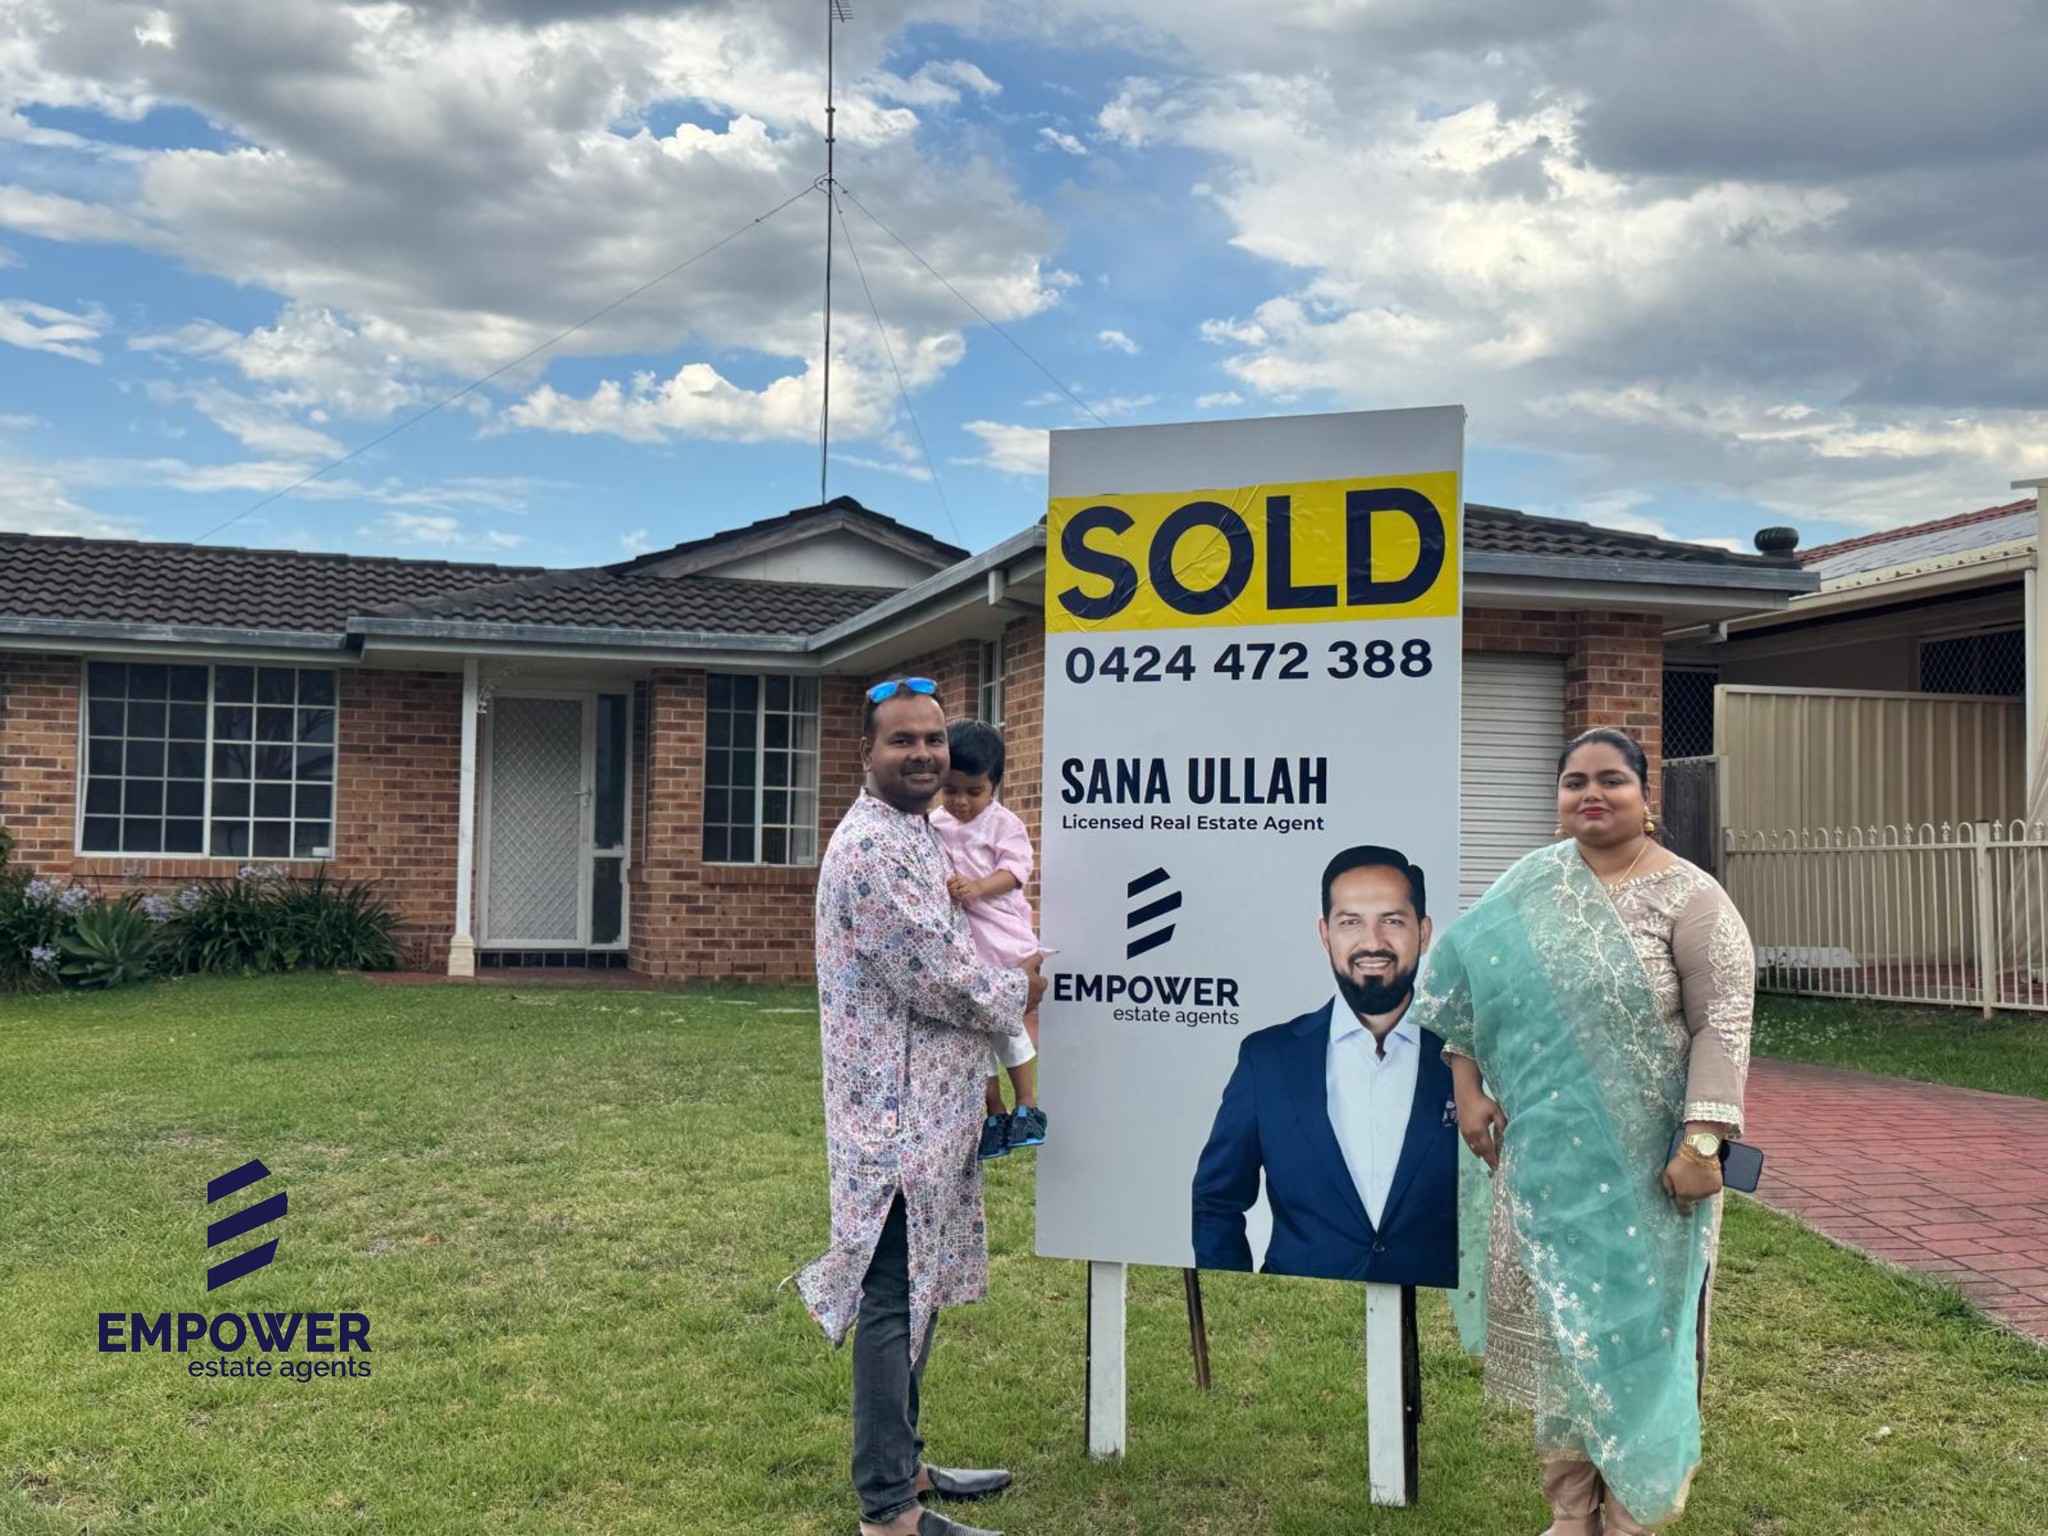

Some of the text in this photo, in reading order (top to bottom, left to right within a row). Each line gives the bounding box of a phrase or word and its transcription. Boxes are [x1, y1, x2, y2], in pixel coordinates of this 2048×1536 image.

[1057, 487, 1446, 620] SOLD
[1065, 638, 1433, 684] 0424 472 388
[1061, 757, 1328, 805] SANA ULLAH
[1062, 814, 1325, 834] Licensed Real Estate Agent
[1053, 973, 1240, 1007] EMPOWER
[1113, 1007, 1239, 1027] estate agents
